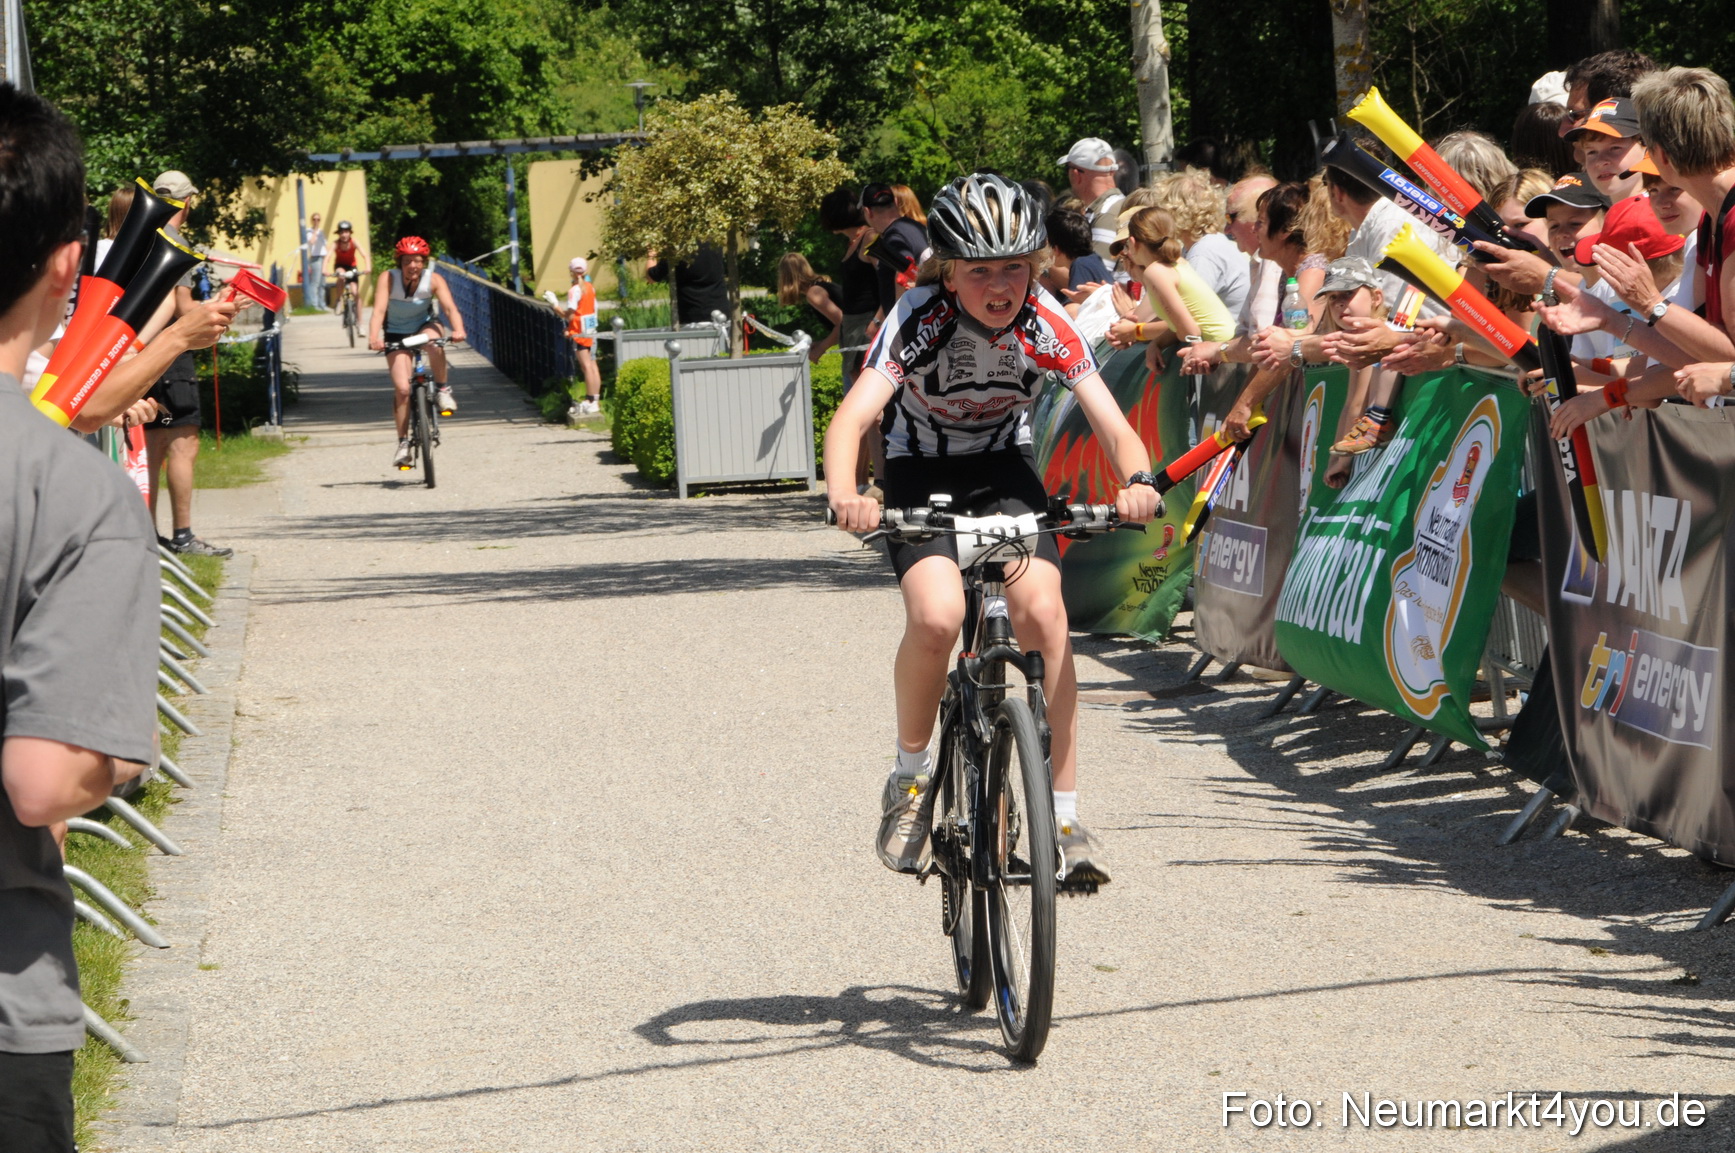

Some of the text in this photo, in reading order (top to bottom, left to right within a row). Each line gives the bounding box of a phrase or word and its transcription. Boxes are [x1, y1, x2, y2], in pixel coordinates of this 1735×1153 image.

[1413, 160, 1442, 187] GERMANY
[1384, 173, 1466, 229] tri energy
[107, 334, 129, 360] MADE
[1455, 297, 1514, 350] MADE IN GERMANY
[99, 357, 111, 370] IN
[69, 367, 103, 410] GERMANY
[1209, 532, 1260, 585] energy
[1580, 630, 1712, 732] tri energy
